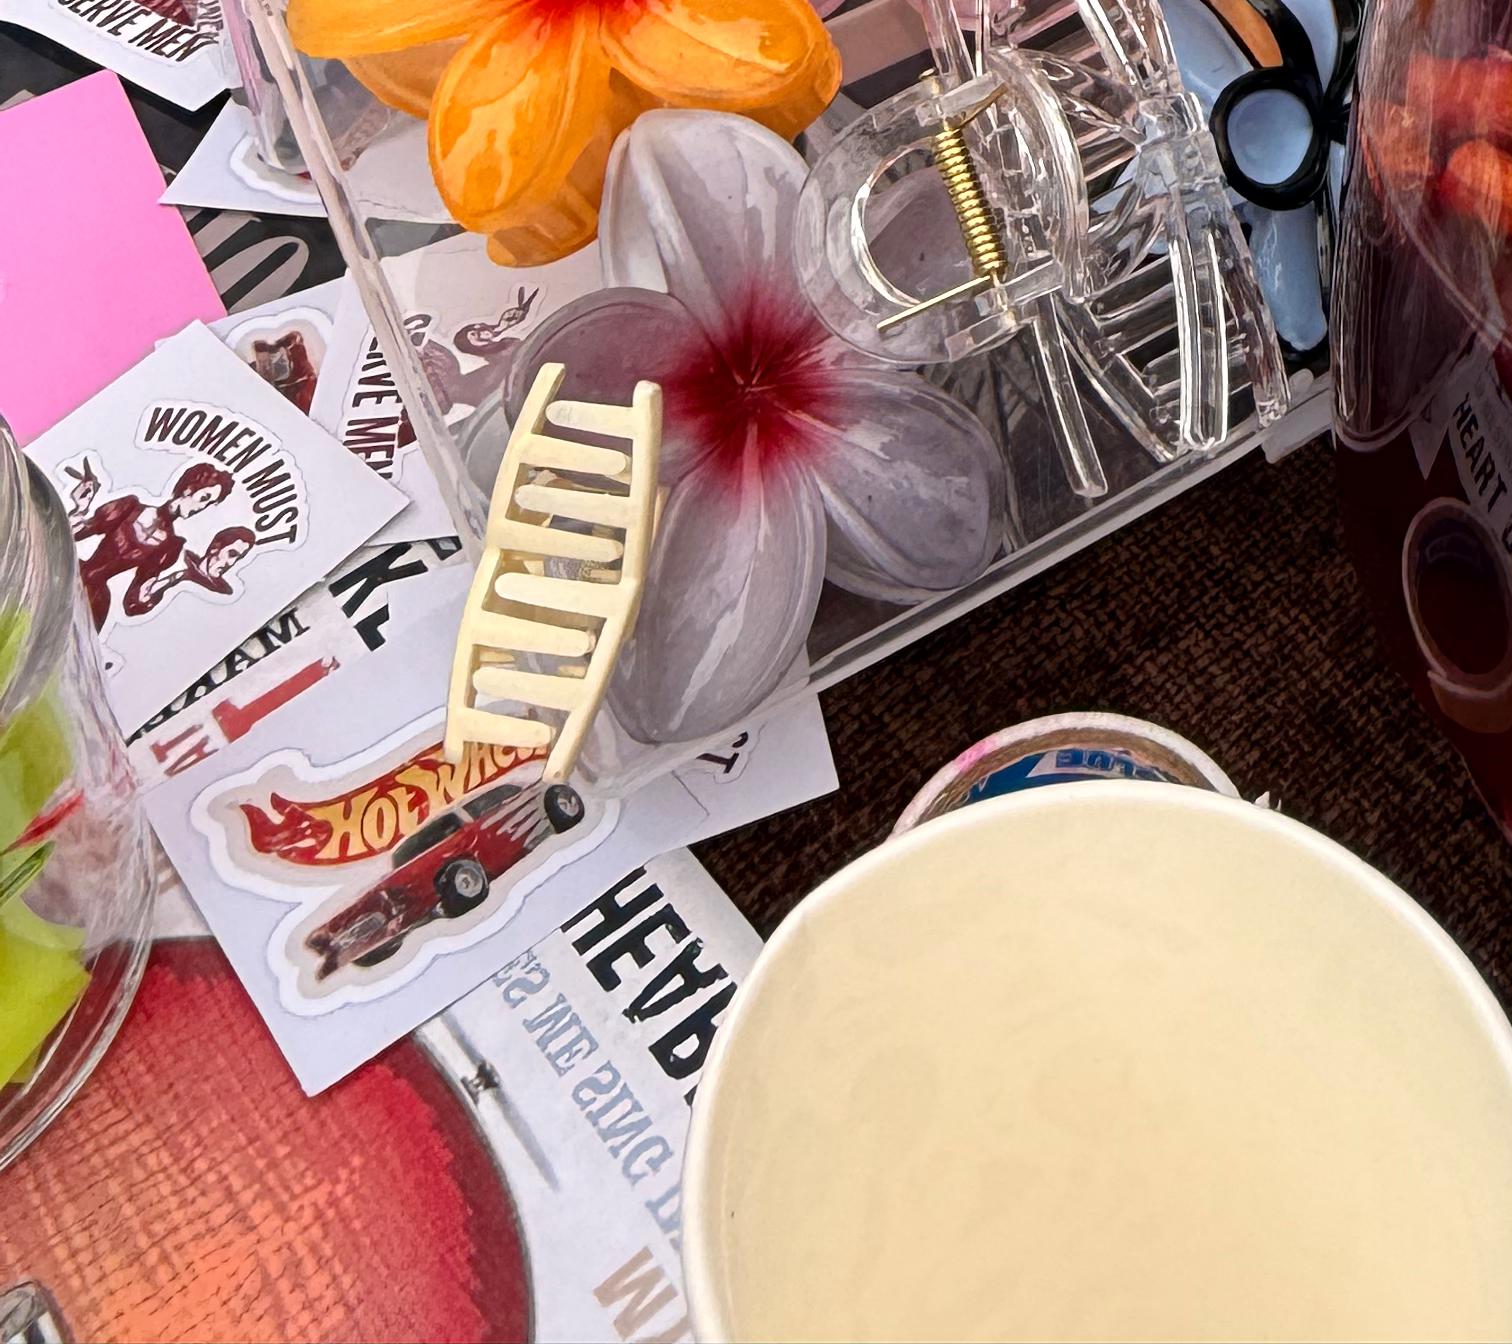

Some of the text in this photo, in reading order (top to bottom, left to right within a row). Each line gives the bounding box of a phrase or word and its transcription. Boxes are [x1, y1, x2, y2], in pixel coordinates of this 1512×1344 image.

[128, 19, 204, 62] MEN
[144, 407, 299, 546] WOMEN MUST
[1453, 392, 1507, 512] HEART
